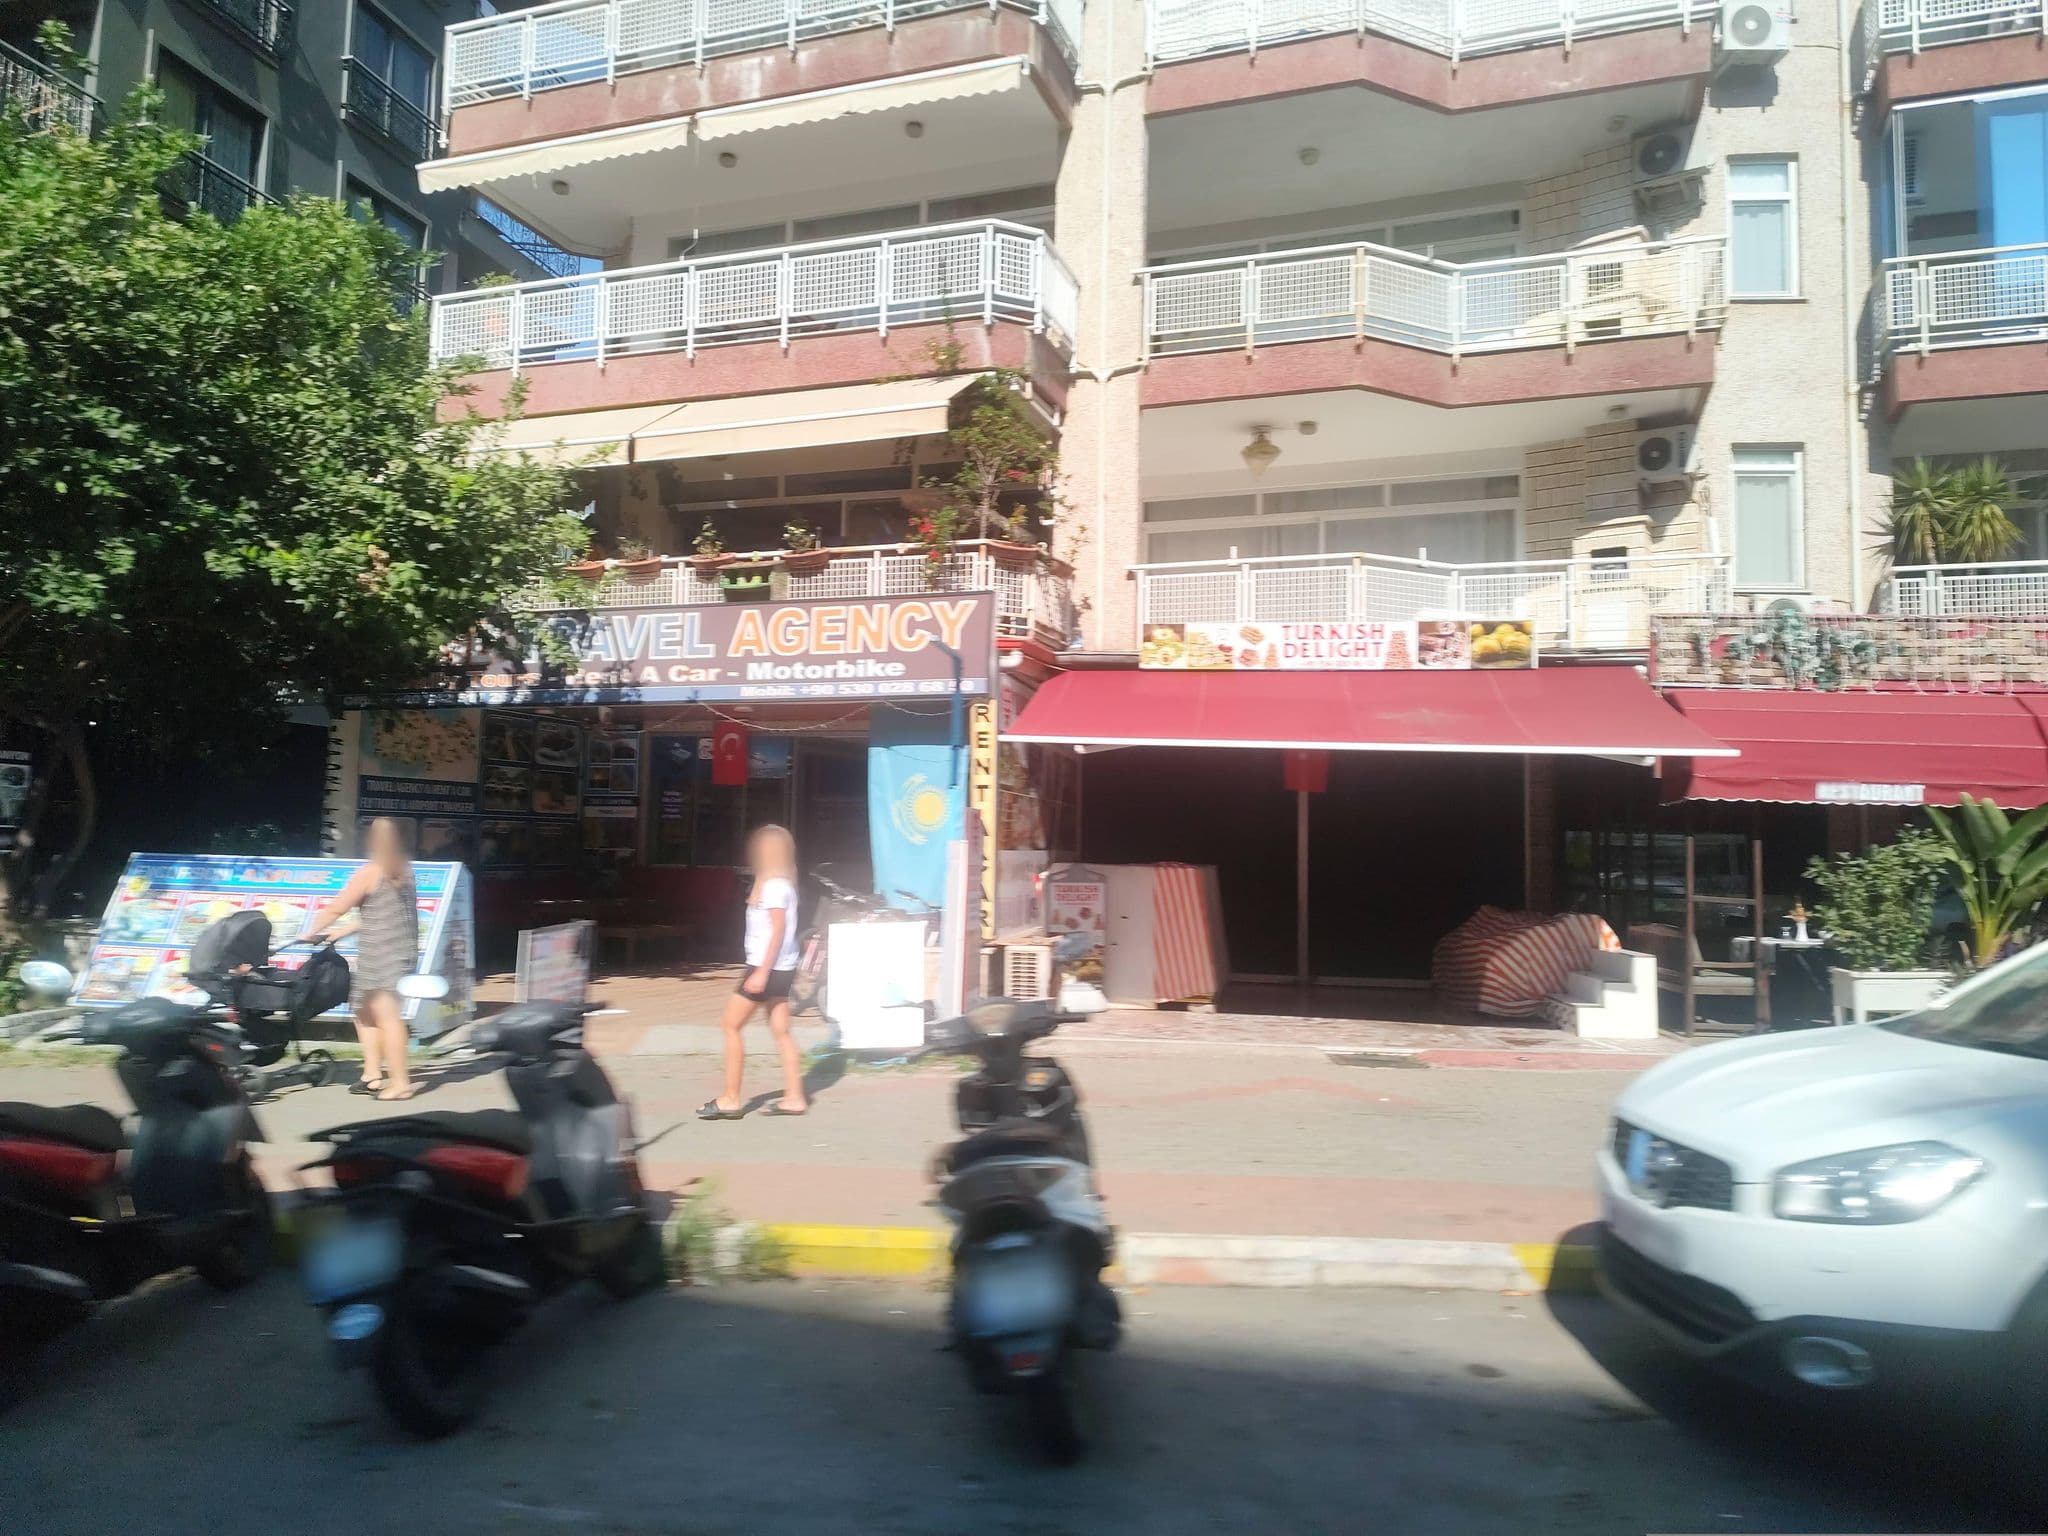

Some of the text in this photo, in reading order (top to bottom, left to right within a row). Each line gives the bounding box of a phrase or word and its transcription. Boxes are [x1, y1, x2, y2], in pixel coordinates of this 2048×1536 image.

[727, 599, 979, 657] AGENCY
[1280, 623, 1385, 640] TURKISH
[1282, 641, 1385, 659] DELIGHT
[641, 666, 661, 683] A
[667, 664, 720, 683] Car
[746, 659, 907, 681] Motorbike
[974, 704, 991, 802] RENT
